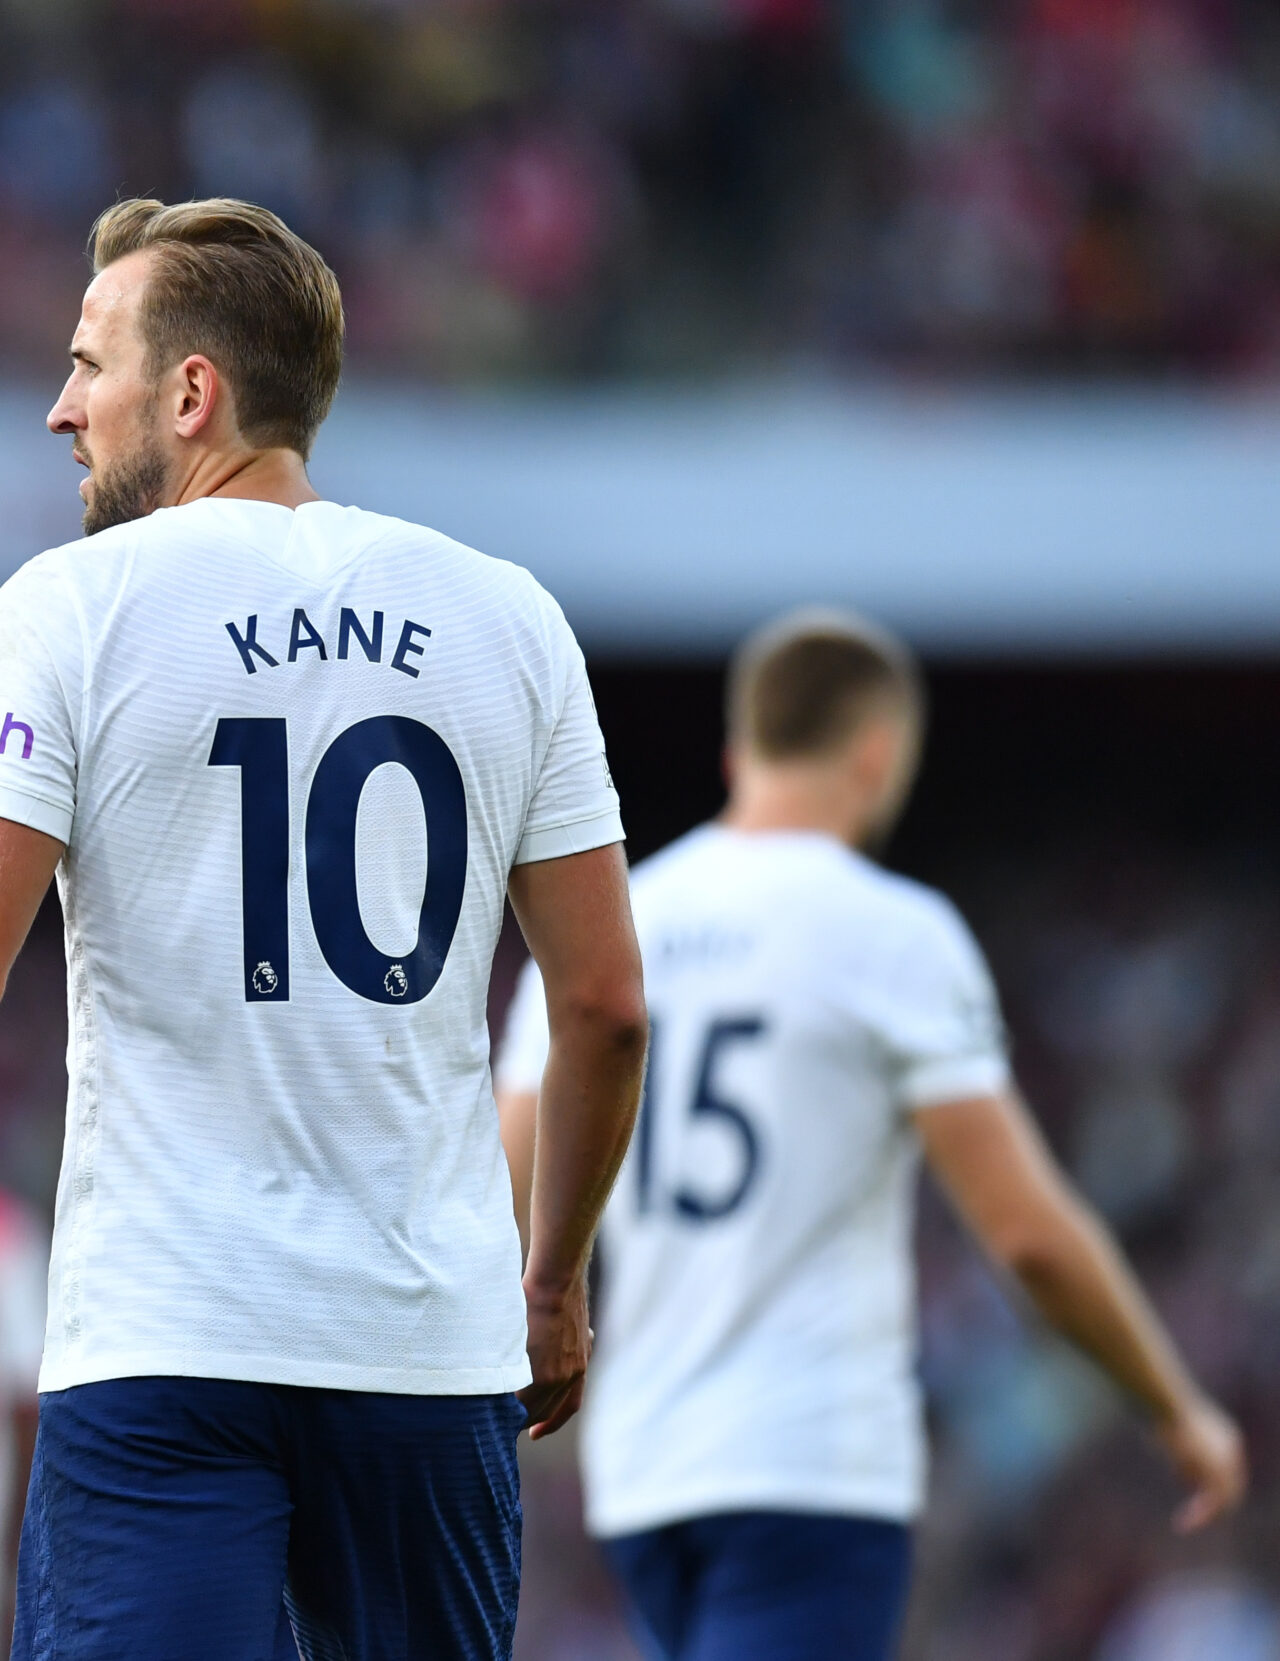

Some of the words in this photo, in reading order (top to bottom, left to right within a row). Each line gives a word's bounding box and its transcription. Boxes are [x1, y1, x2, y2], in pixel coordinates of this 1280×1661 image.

[225, 606, 432, 678] KANE
[207, 714, 468, 1005] 10
[634, 1010, 768, 1222] 15
